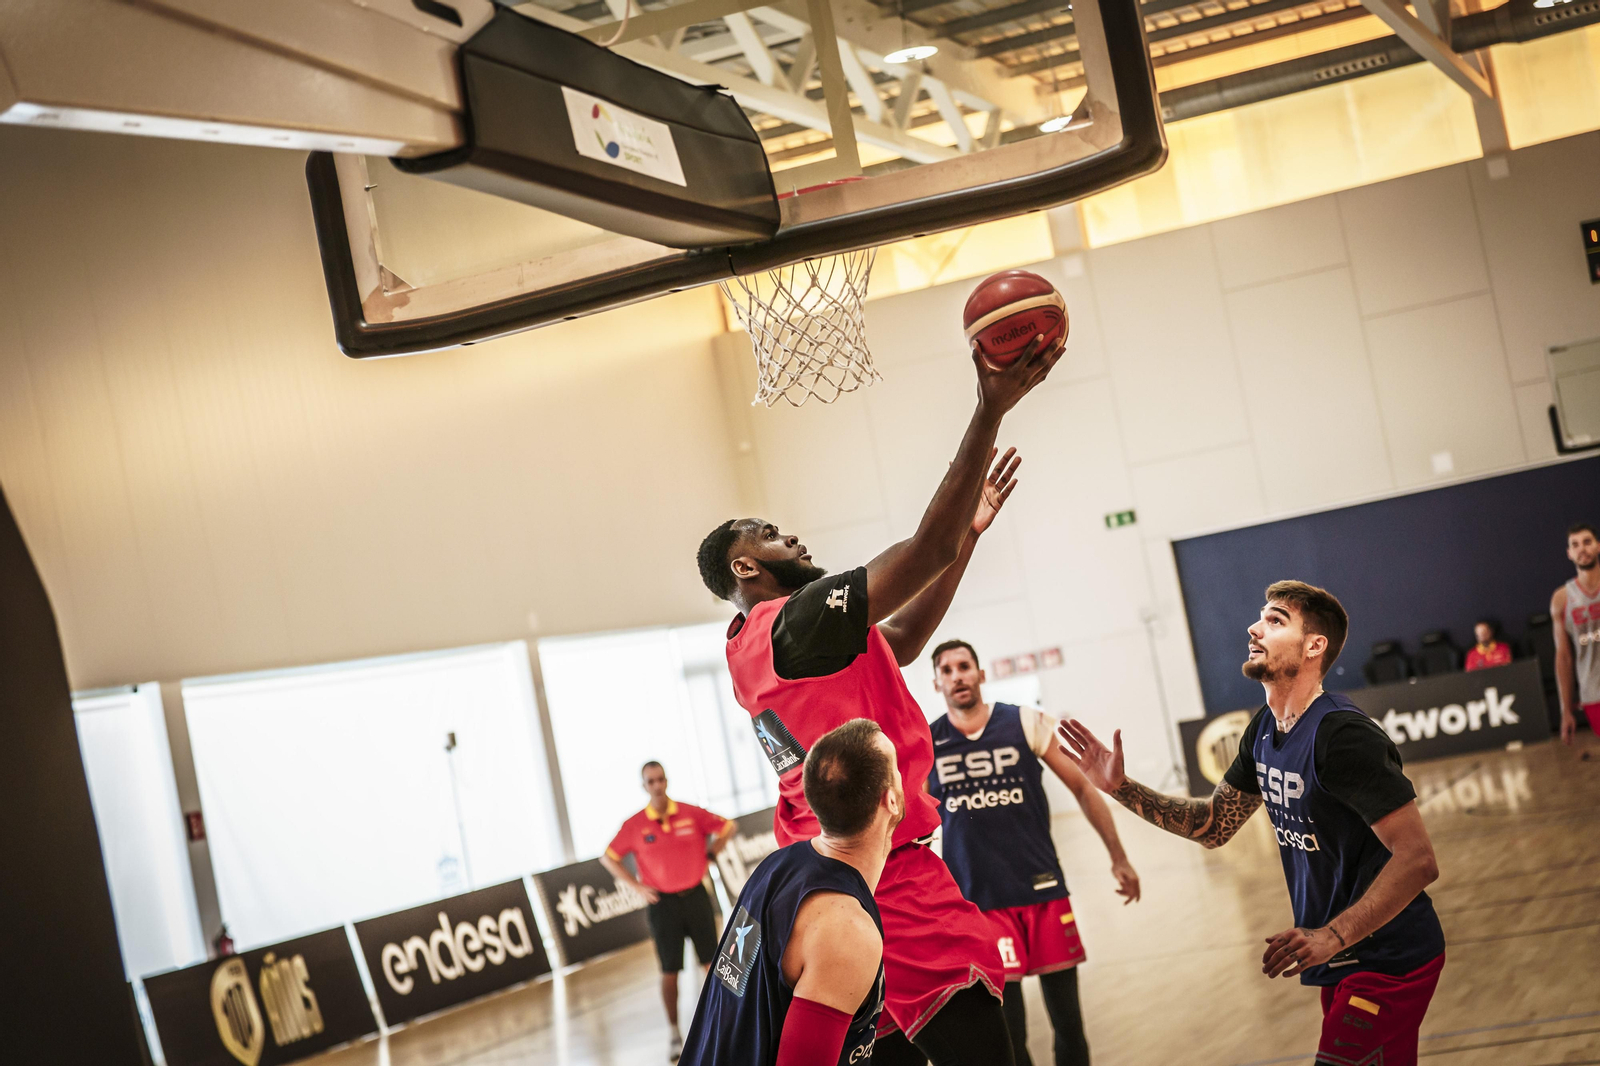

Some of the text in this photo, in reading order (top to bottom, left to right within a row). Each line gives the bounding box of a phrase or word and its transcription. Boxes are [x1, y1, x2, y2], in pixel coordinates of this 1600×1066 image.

[991, 322, 1037, 346] molten
[1370, 687, 1520, 745] twork
[772, 751, 800, 771] CaixaBank
[935, 746, 1020, 785] ESP
[946, 788, 1024, 813] endesa
[1256, 762, 1304, 808] ESP
[1272, 823, 1320, 851] desa
[381, 906, 534, 996] endesa
